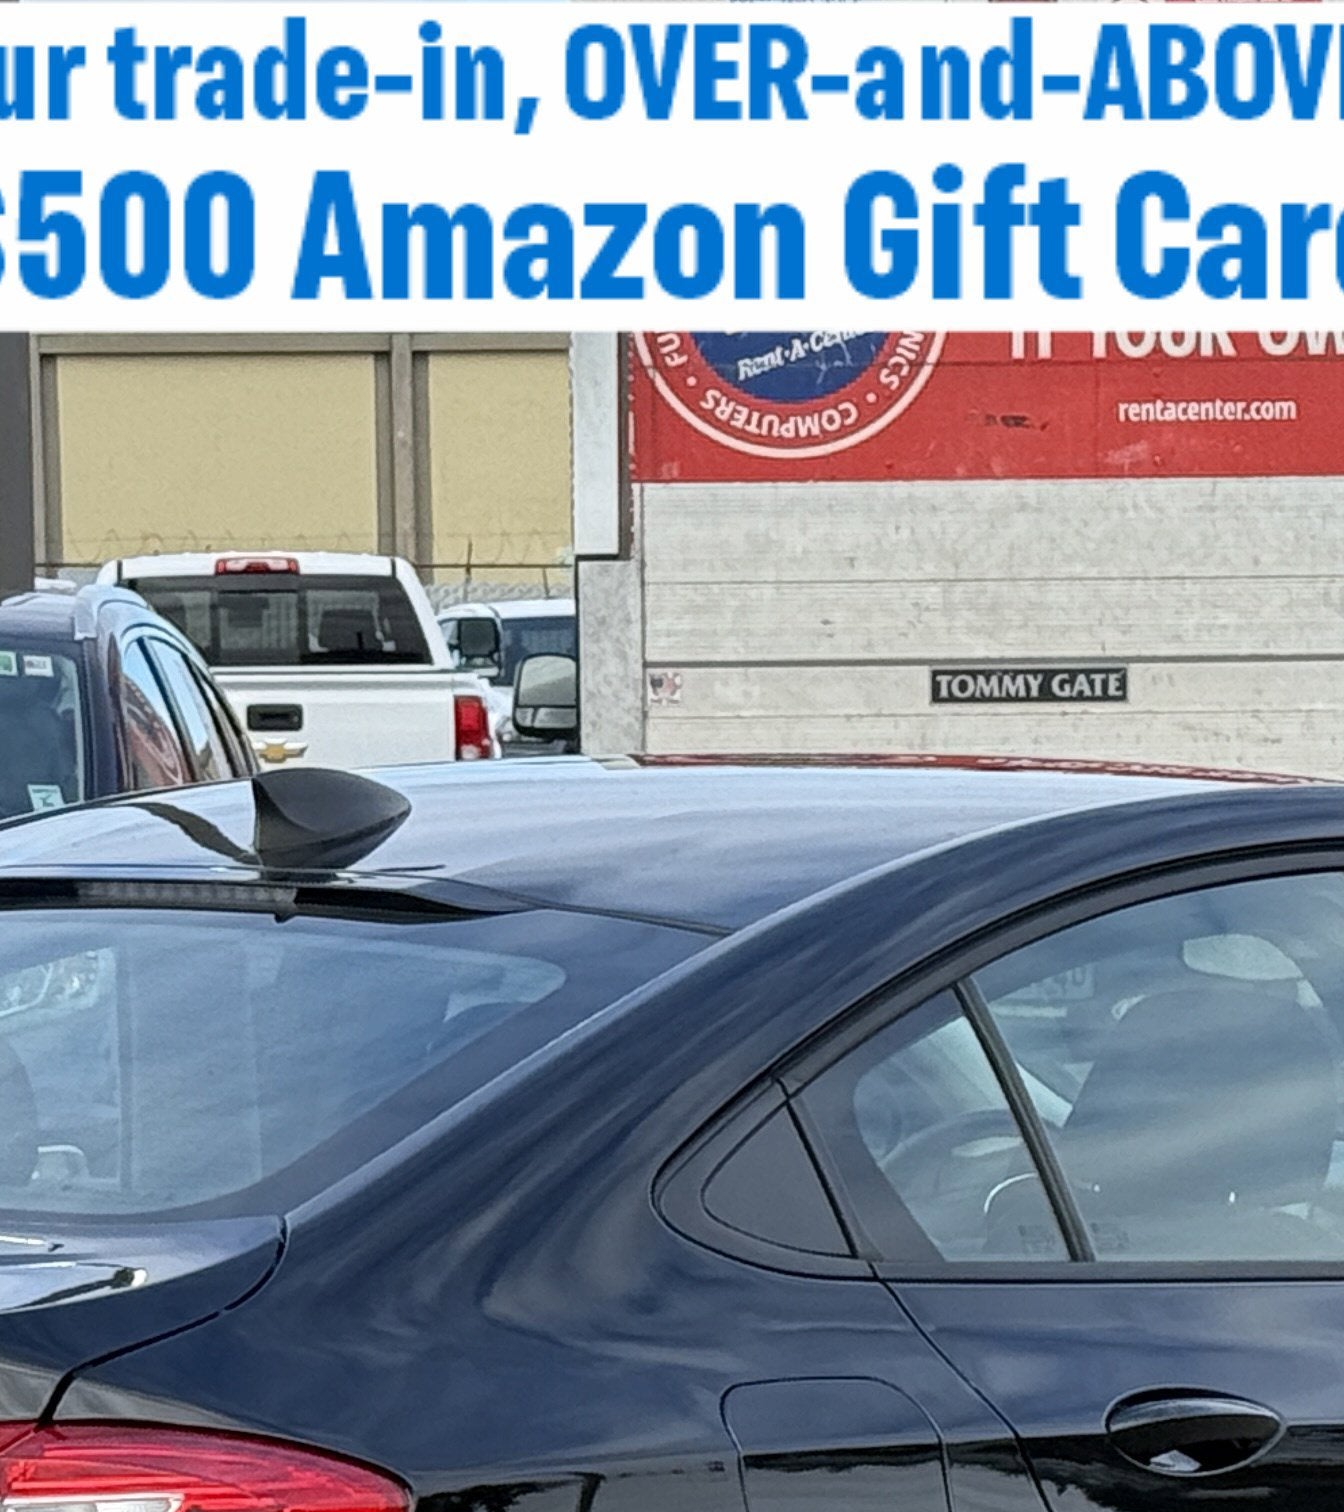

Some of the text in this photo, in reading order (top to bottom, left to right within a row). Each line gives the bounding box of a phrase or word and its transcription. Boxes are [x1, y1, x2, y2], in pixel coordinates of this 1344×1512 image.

[700, 388, 860, 440] COMPUTERS
[1117, 397, 1298, 423] rentacenter.com
[935, 671, 1124, 699] TOMMY GATE
